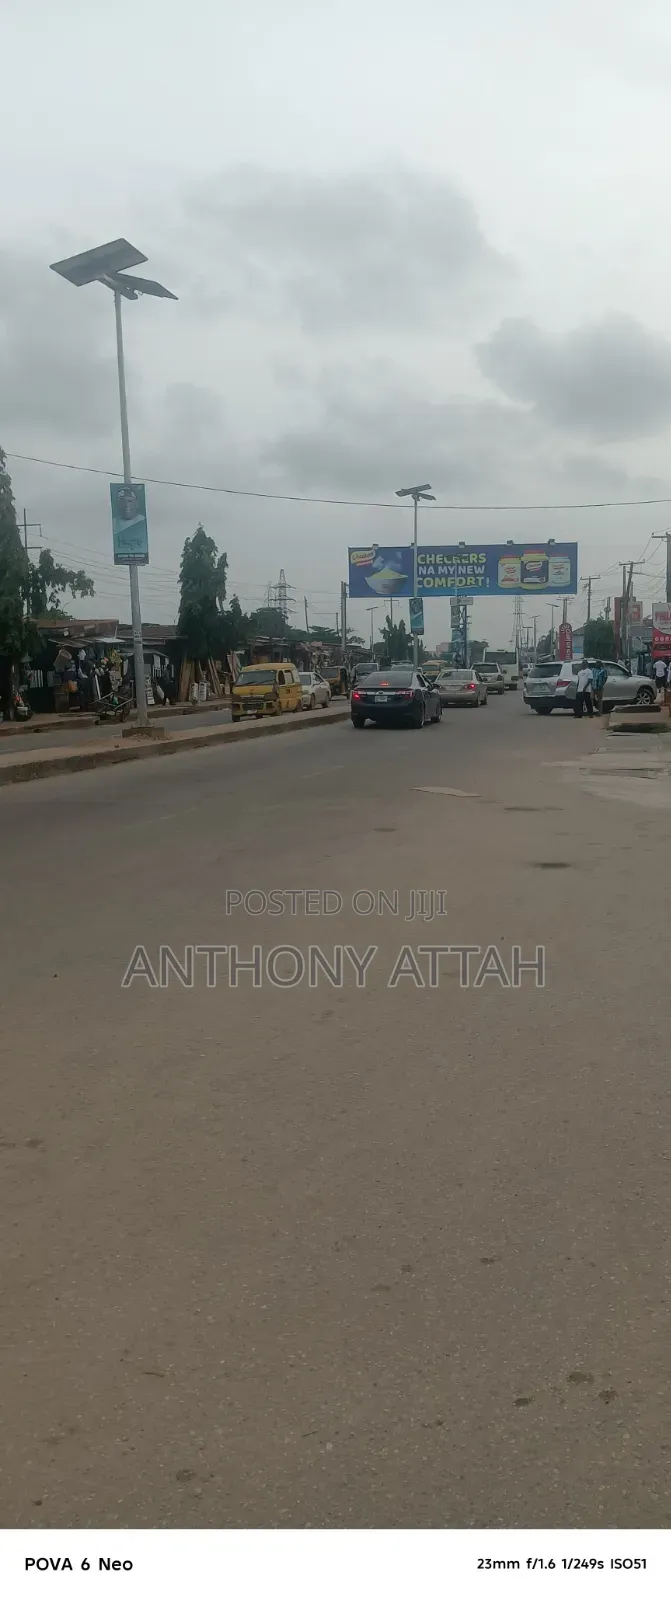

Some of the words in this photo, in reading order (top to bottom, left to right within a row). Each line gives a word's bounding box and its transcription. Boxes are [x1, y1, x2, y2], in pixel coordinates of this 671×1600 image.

[418, 566, 435, 575] NA
[437, 565, 455, 575] MY
[458, 565, 485, 575] NEW
